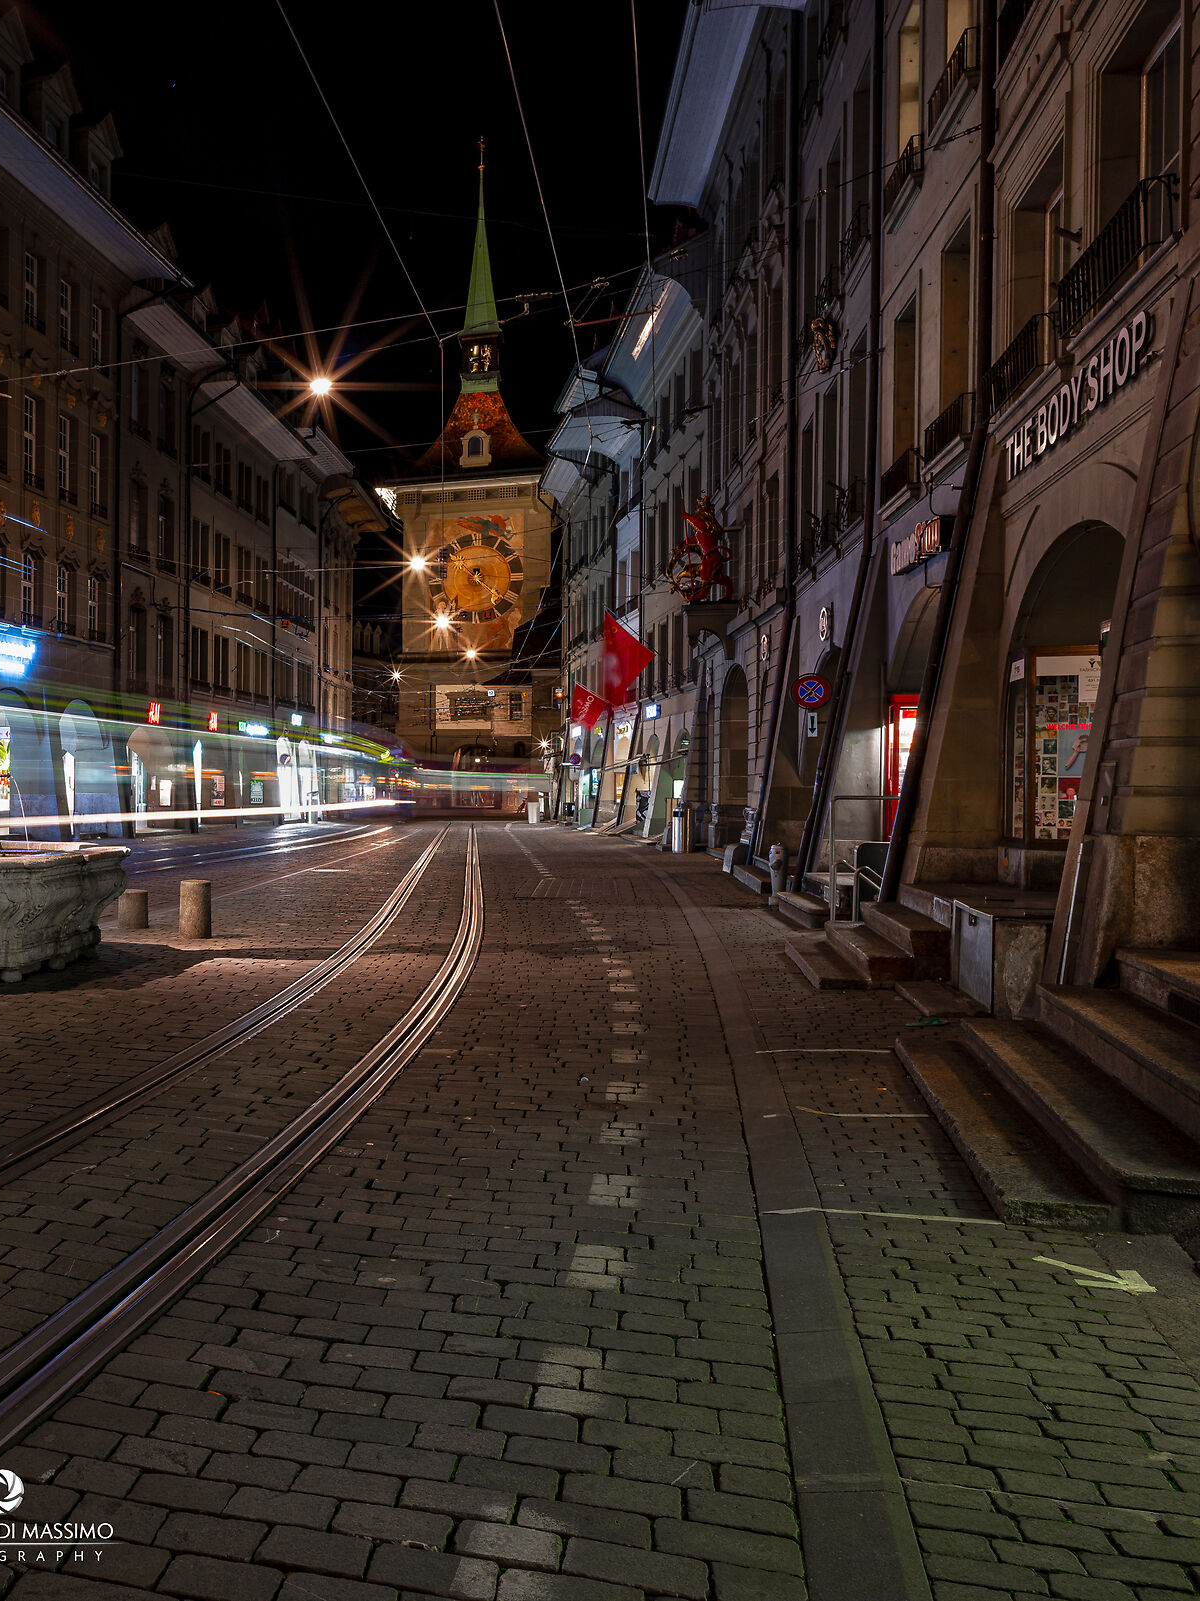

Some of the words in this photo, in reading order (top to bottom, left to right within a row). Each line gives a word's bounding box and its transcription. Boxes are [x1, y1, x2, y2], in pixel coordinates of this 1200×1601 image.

[1004, 420, 1033, 481] THE
[1035, 368, 1083, 456] BODY
[1086, 311, 1147, 411] SHOP
